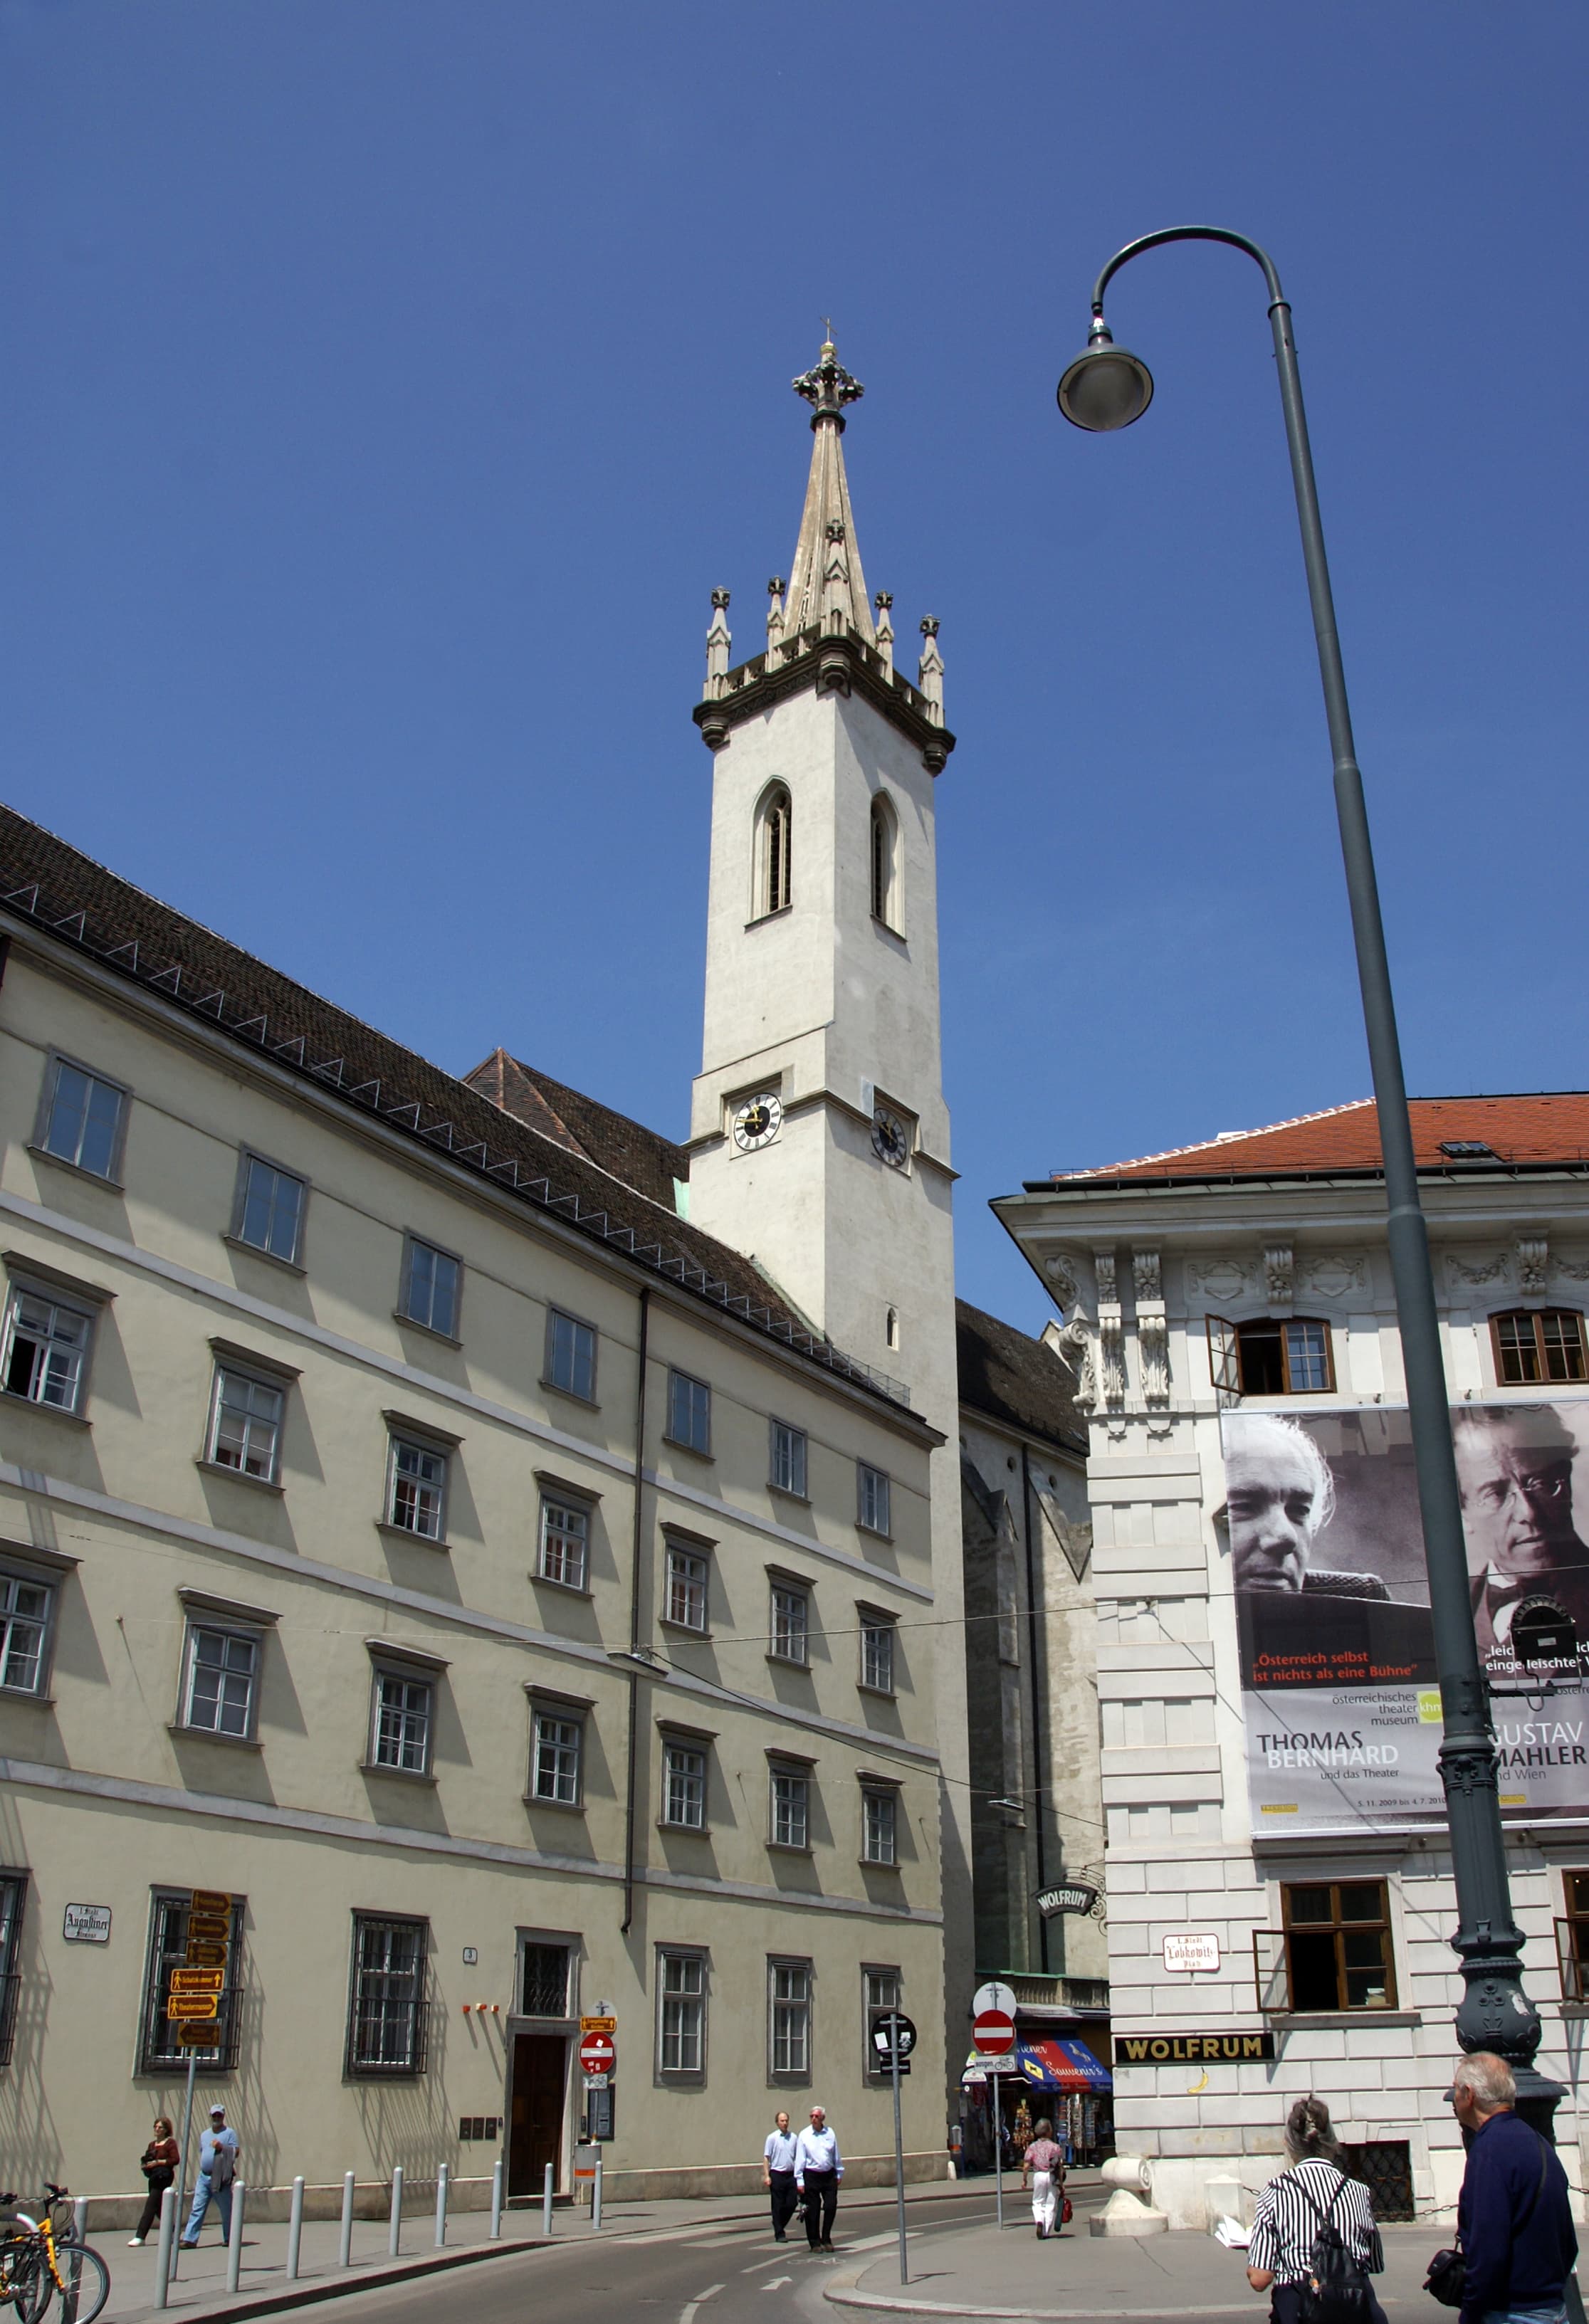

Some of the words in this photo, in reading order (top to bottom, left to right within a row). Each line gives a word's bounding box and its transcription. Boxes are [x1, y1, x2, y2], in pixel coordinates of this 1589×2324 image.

[1331, 1651, 1368, 1663] selbst
[1253, 1669, 1268, 1682] ist
[1273, 1667, 1312, 1681] nichts
[1316, 1667, 1333, 1680] als
[1338, 1666, 1365, 1678] eine
[1333, 1692, 1416, 1705] österreichisches
[1379, 1704, 1417, 1714] theater
[1371, 1716, 1419, 1725] museum
[1257, 1730, 1363, 1753] THOMAS
[1267, 1745, 1399, 1769] BERNHARD
[1321, 1770, 1340, 1779] und
[1343, 1770, 1360, 1779] das
[1362, 1769, 1400, 1778] Theater
[1514, 1768, 1547, 1779] Wien
[1038, 1891, 1088, 1910] WOLFRUM
[1017, 2044, 1047, 2054] iener
[1125, 2036, 1262, 2060] WOLFRUM
